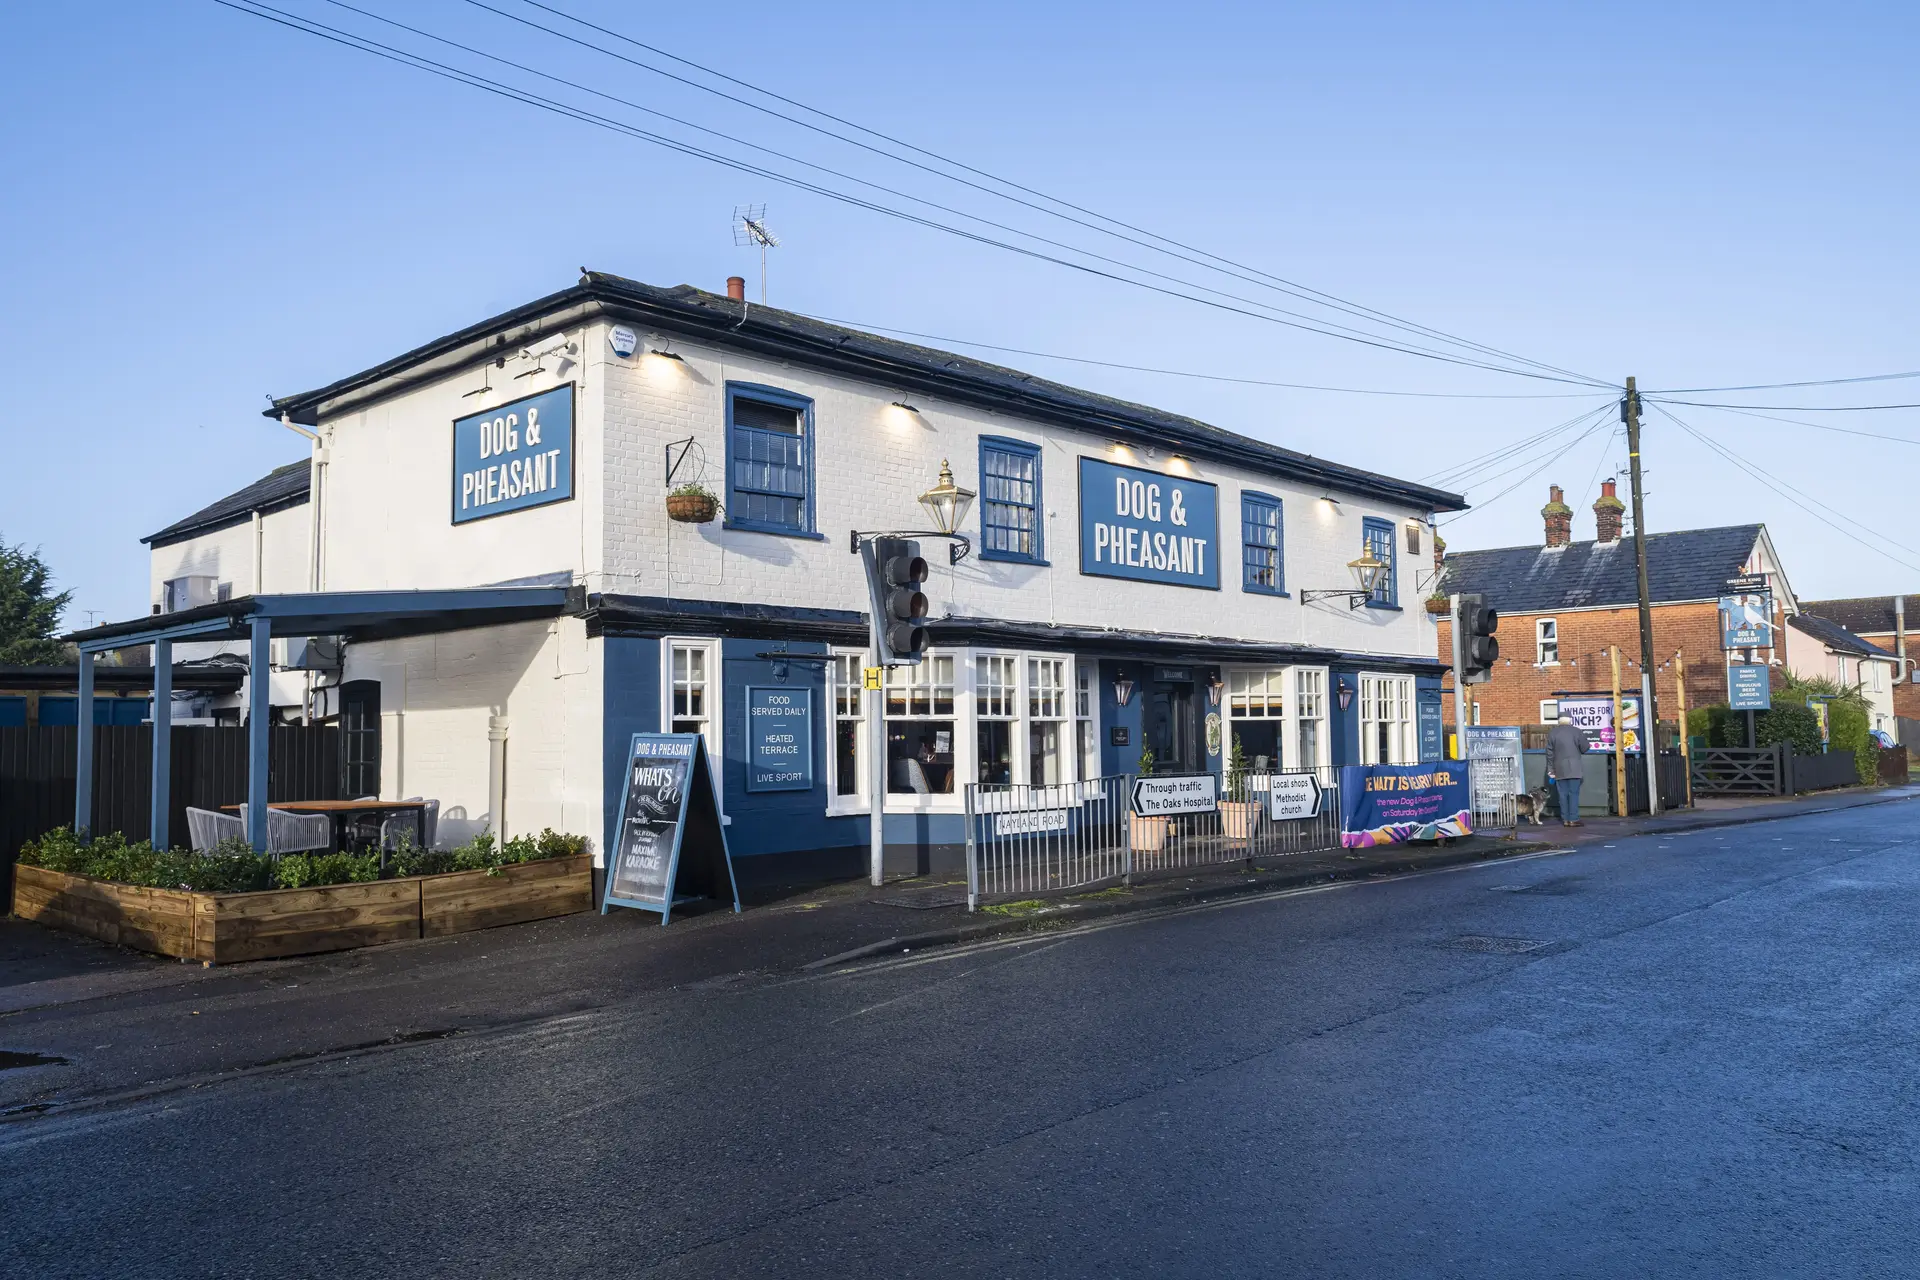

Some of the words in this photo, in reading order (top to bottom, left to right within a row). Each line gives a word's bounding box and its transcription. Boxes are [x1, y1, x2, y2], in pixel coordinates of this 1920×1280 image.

[616, 331, 634, 339] Mercury
[616, 336, 634, 344] Systems
[480, 414, 518, 460] DOG
[526, 408, 541, 446] &
[462, 450, 560, 510] PHEASANT
[1116, 478, 1161, 522] DOG
[1170, 489, 1187, 526] &
[1095, 522, 1207, 575] PHEASANT
[866, 670, 878, 687] H
[768, 696, 790, 704] FOOD
[751, 708, 782, 716] SERVED
[784, 708, 806, 716] DAILY
[1564, 706, 1596, 715] WHAT'S
[1597, 706, 1610, 715] FOR
[766, 735, 794, 743] HEATED
[636, 743, 650, 755] DOG
[652, 743, 657, 755] &
[658, 743, 692, 756] PHEASANT
[760, 746, 798, 754] TERRACE
[757, 774, 773, 782] LIVE
[776, 772, 802, 782] SPORT
[1146, 783, 1177, 794] Through
[1179, 782, 1202, 792] traffic
[1273, 779, 1290, 788] Local
[1291, 779, 1308, 788] shops
[1373, 776, 1396, 791] WAIT
[1397, 776, 1410, 790] IS
[657, 785, 680, 804] on
[1276, 793, 1306, 803] Methodist
[1146, 800, 1160, 809] The
[1162, 798, 1181, 808] Oaks
[1184, 796, 1213, 808] Hospital
[1377, 798, 1386, 806] the
[1400, 798, 1414, 806] Dog
[1281, 805, 1302, 814] church
[1390, 808, 1417, 817] Saturday
[1042, 814, 1065, 825] ROAD
[626, 854, 661, 870] KARAOKE
